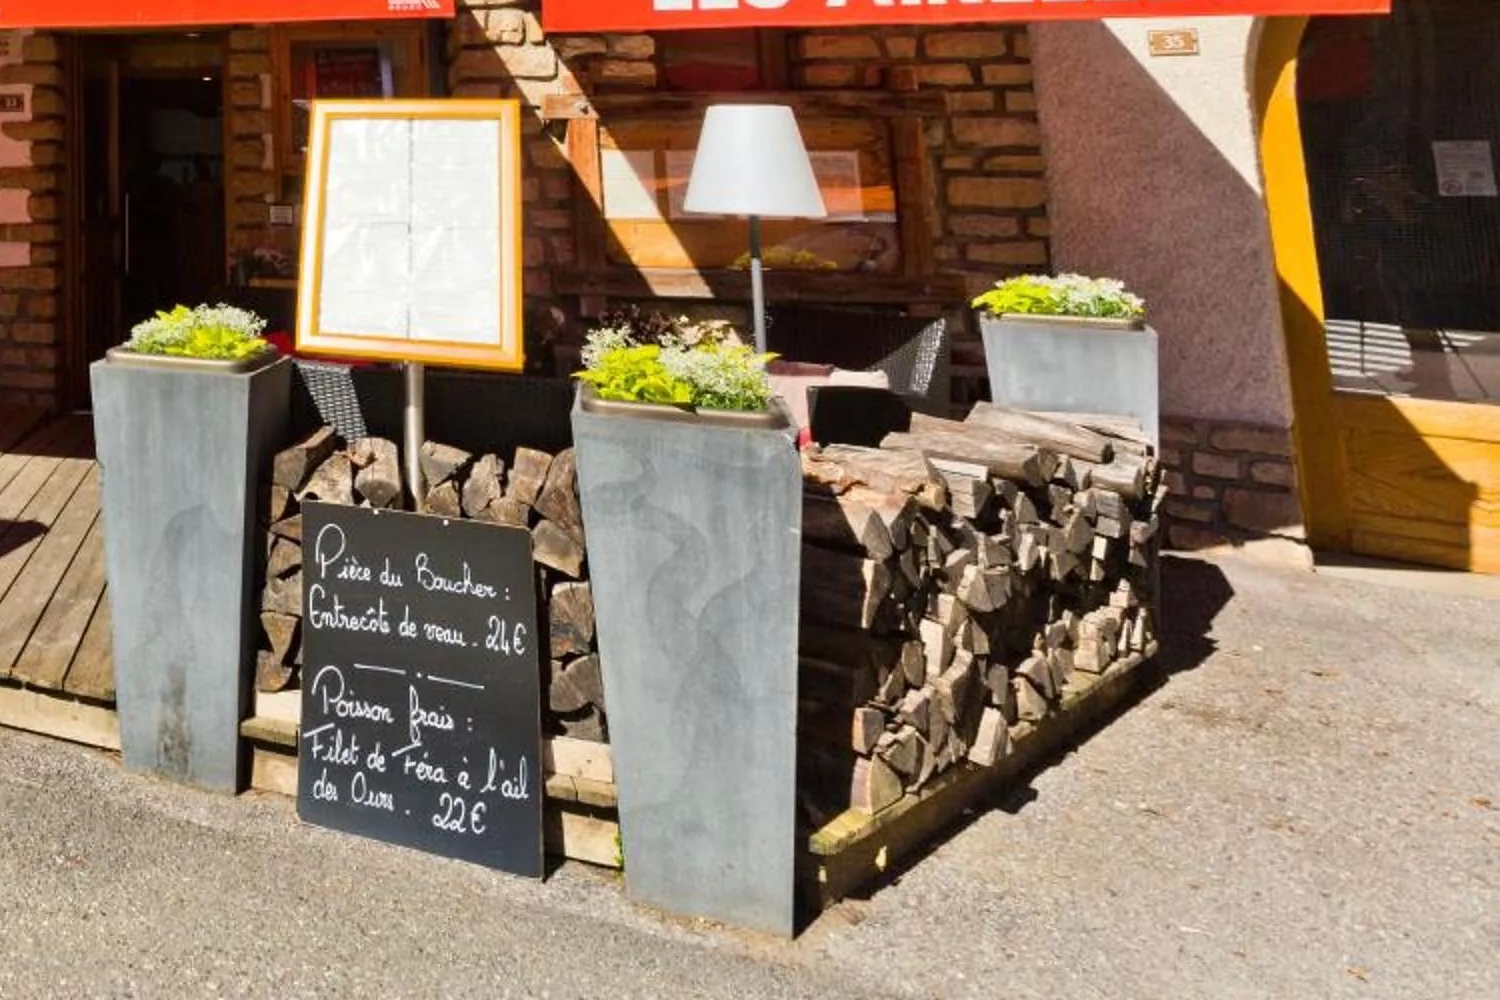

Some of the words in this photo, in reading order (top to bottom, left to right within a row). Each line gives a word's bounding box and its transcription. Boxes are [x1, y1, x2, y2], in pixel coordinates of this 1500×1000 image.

[1163, 35, 1185, 49] 35
[315, 523, 371, 579] Pièce
[380, 557, 403, 587] du
[415, 553, 498, 598] Boucher
[400, 604, 417, 638] de
[423, 624, 466, 647] veau
[486, 615, 527, 655] 24€
[311, 665, 394, 723] Poisson
[409, 684, 455, 745] frais
[303, 722, 359, 765] Filet
[366, 742, 386, 772] de
[457, 756, 472, 790] à
[479, 747, 529, 799] l'ail
[312, 767, 339, 801] des
[351, 771, 394, 812] Ours
[432, 792, 487, 834] 22€
